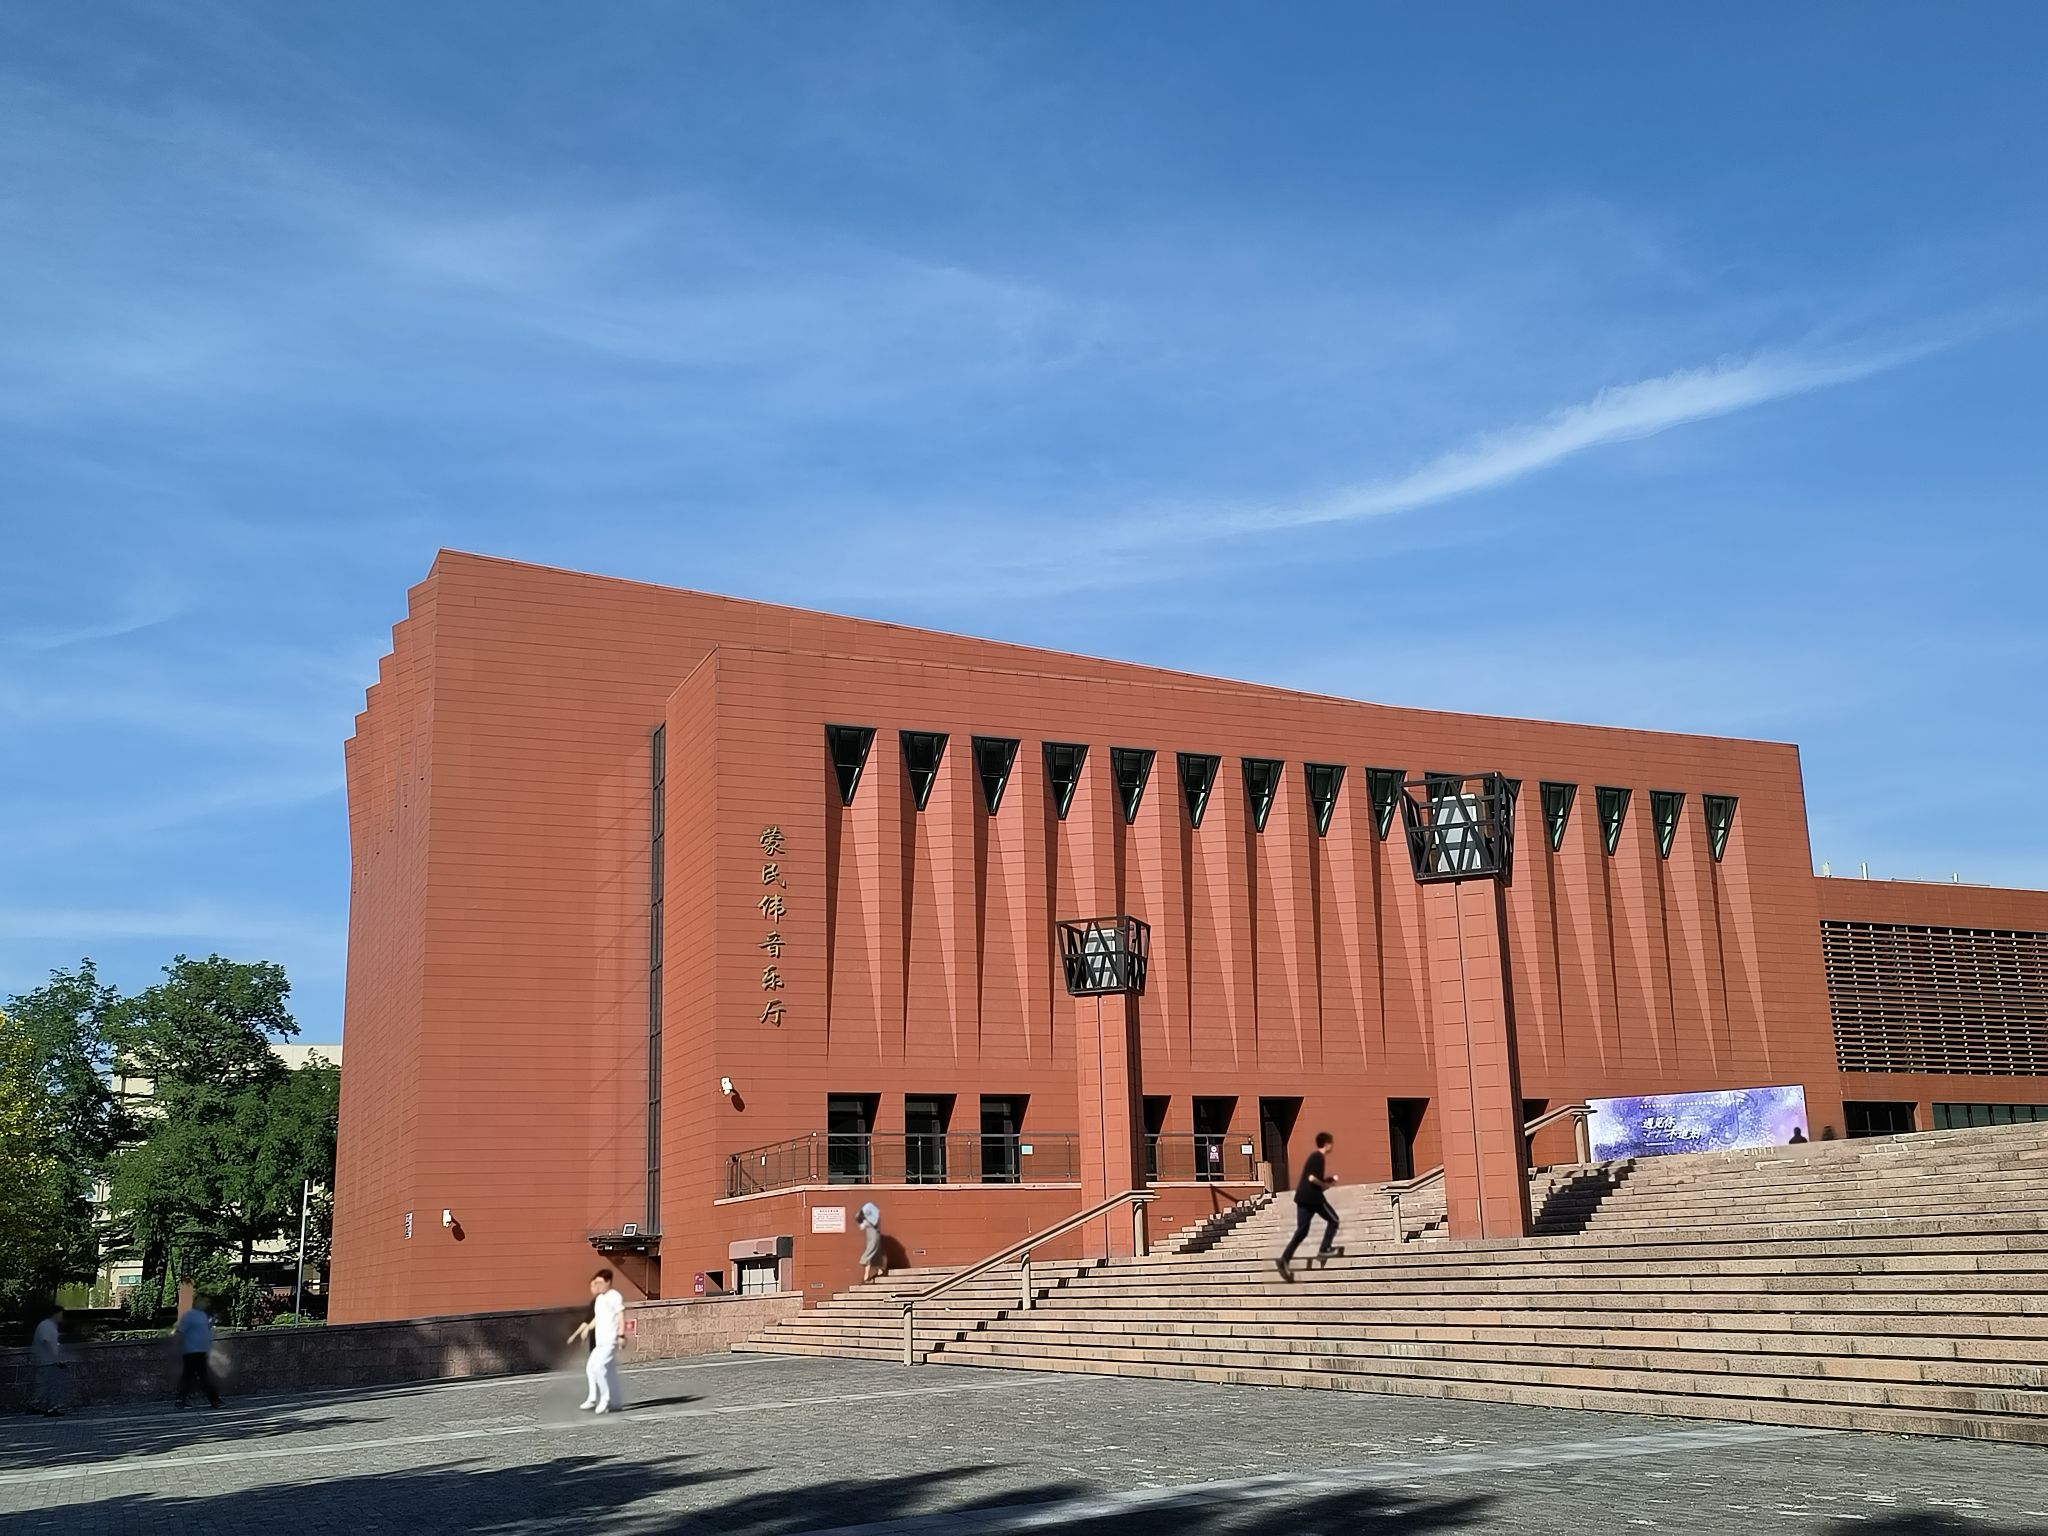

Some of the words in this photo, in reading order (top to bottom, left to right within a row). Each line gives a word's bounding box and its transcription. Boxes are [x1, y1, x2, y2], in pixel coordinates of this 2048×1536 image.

[757, 825, 787, 1027] 蒙民伟音乐厅
